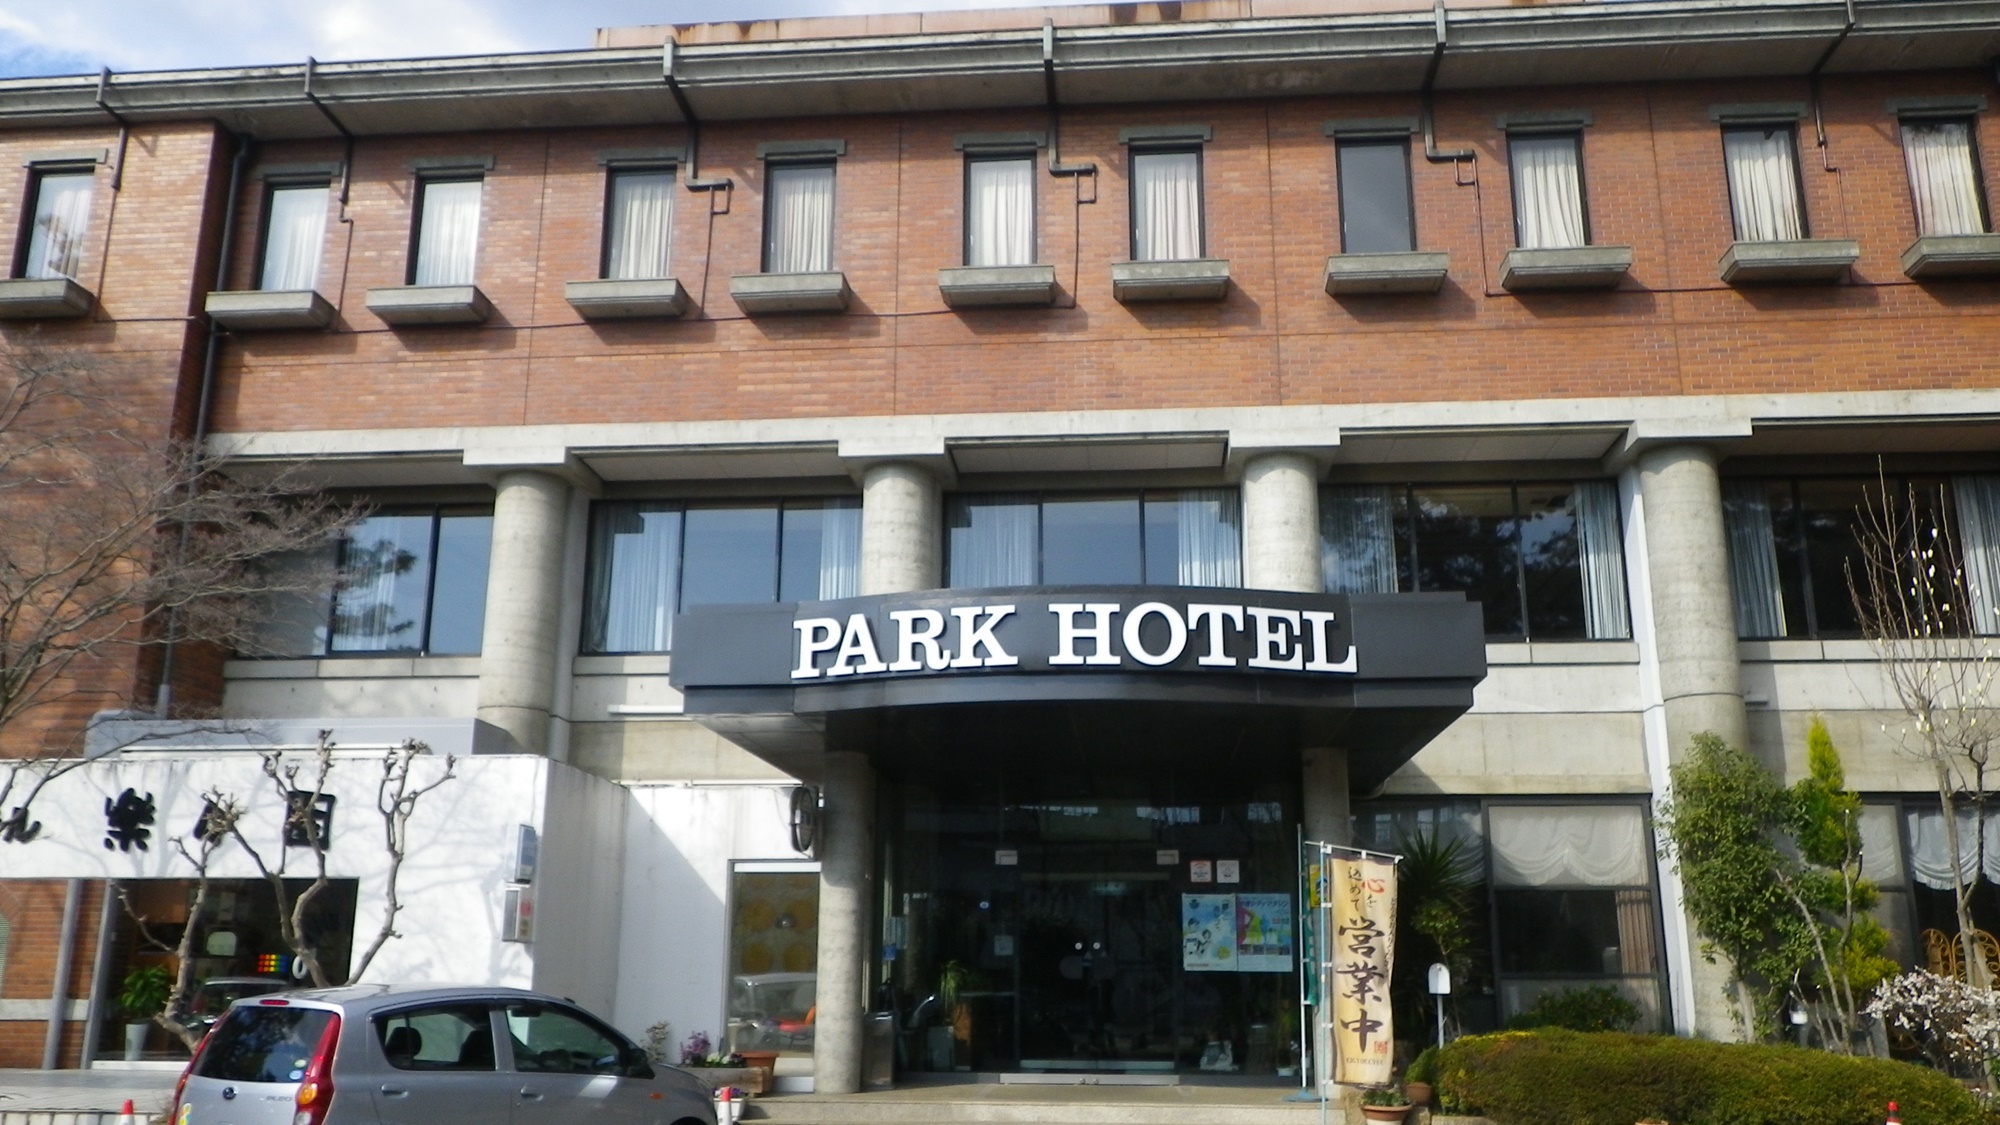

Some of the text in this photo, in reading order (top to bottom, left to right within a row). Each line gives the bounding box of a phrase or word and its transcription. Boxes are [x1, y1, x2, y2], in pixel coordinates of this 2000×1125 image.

[791, 601, 1359, 679] PARK HOTEL
[1348, 866, 1362, 912] 込めて
[1361, 878, 1386, 909] 心を
[1336, 916, 1386, 1054] 営業中
